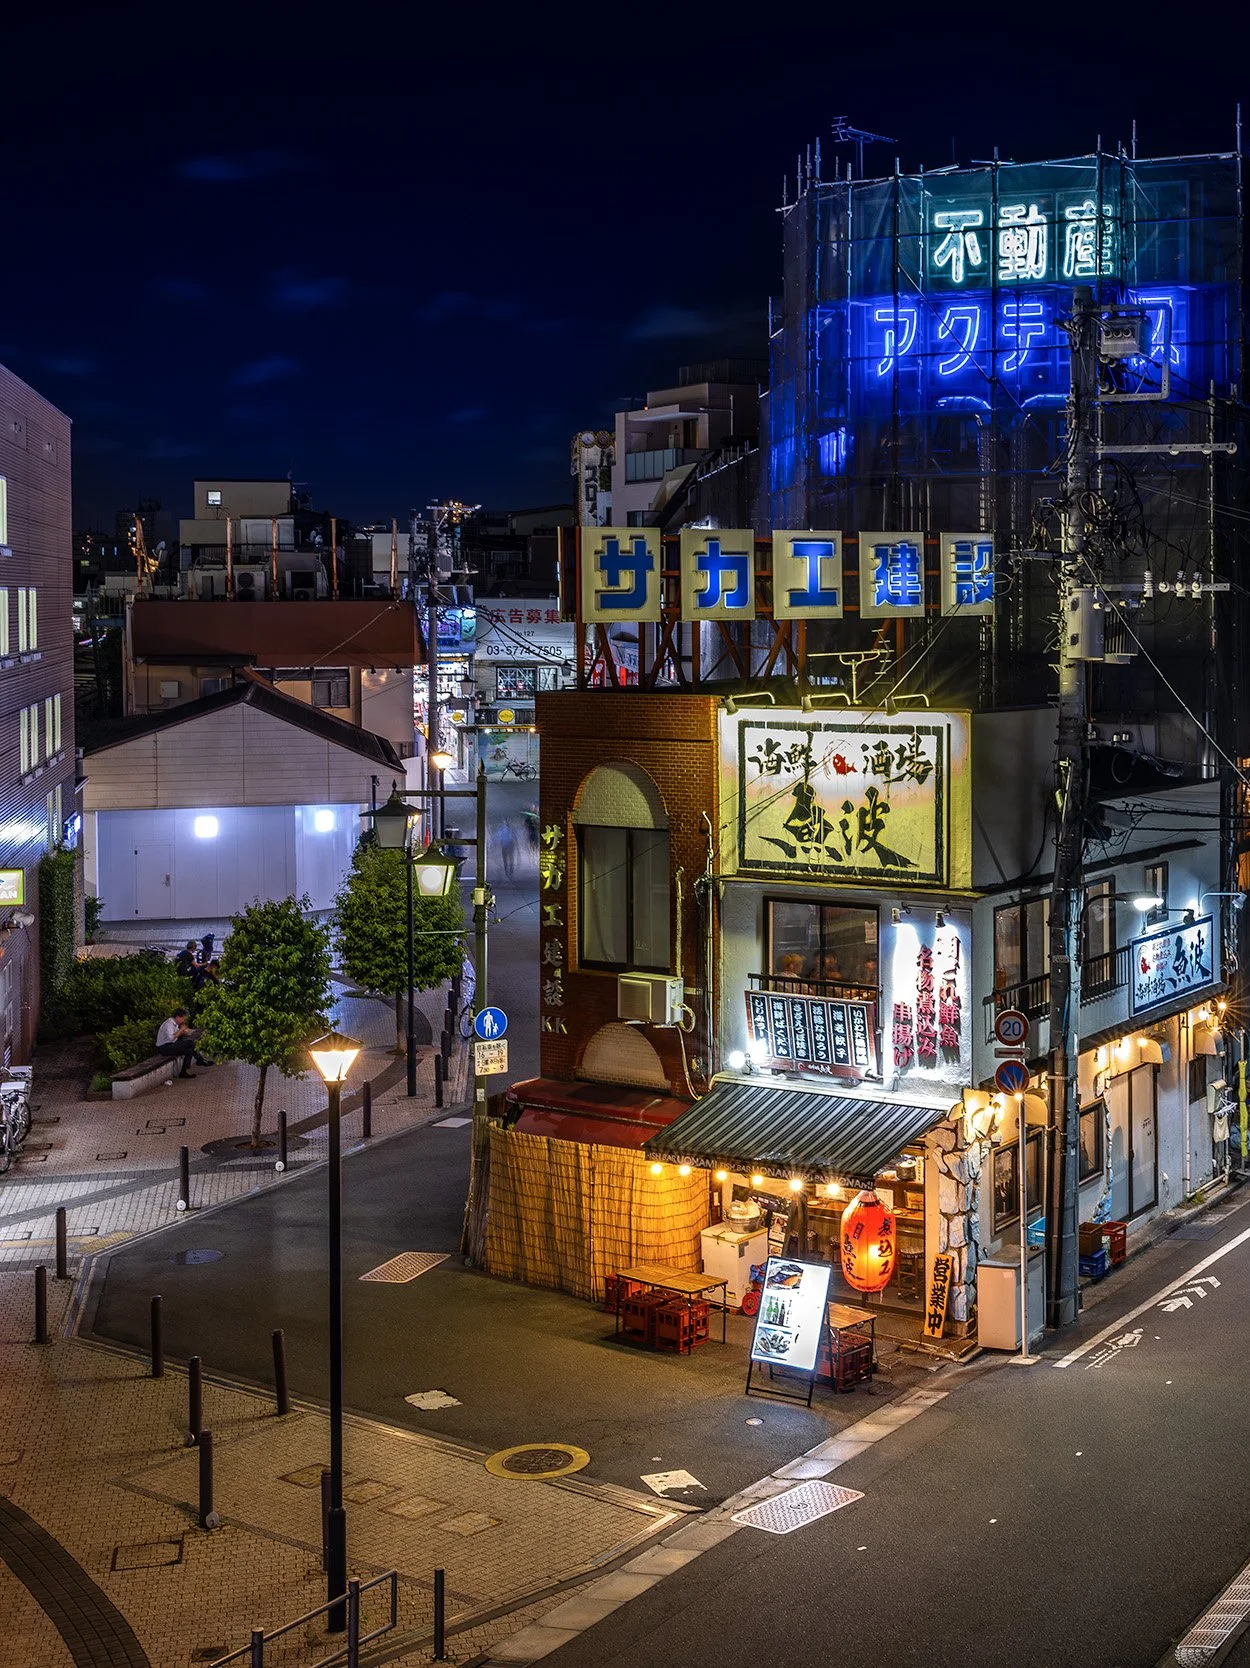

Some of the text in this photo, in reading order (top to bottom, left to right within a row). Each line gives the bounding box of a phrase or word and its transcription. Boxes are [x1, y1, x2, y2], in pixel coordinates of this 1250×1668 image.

[934, 200, 1113, 283] 不動産
[875, 297, 1179, 376] アクテス
[596, 535, 993, 610] サカエ建設
[489, 608, 561, 624] 広告募集
[487, 644, 562, 656] 03-5774-7505
[748, 730, 935, 788] 海鮮 酒場
[758, 782, 920, 867] 魚波
[541, 823, 565, 1007] サカエ建設
[1164, 929, 1213, 989] 魚波
[915, 944, 937, 1057] 名物煮込み
[1002, 1021, 1022, 1037] 20
[891, 1001, 914, 1068] 串揚げ
[677, 1155, 717, 1169] UONAMI
[736, 1164, 752, 1173] BAR
[752, 1166, 796, 1179] UONAMI
[842, 1232, 866, 1281] 魚波
[877, 1217, 894, 1277] 煮込み
[927, 1256, 951, 1336] 営業中
